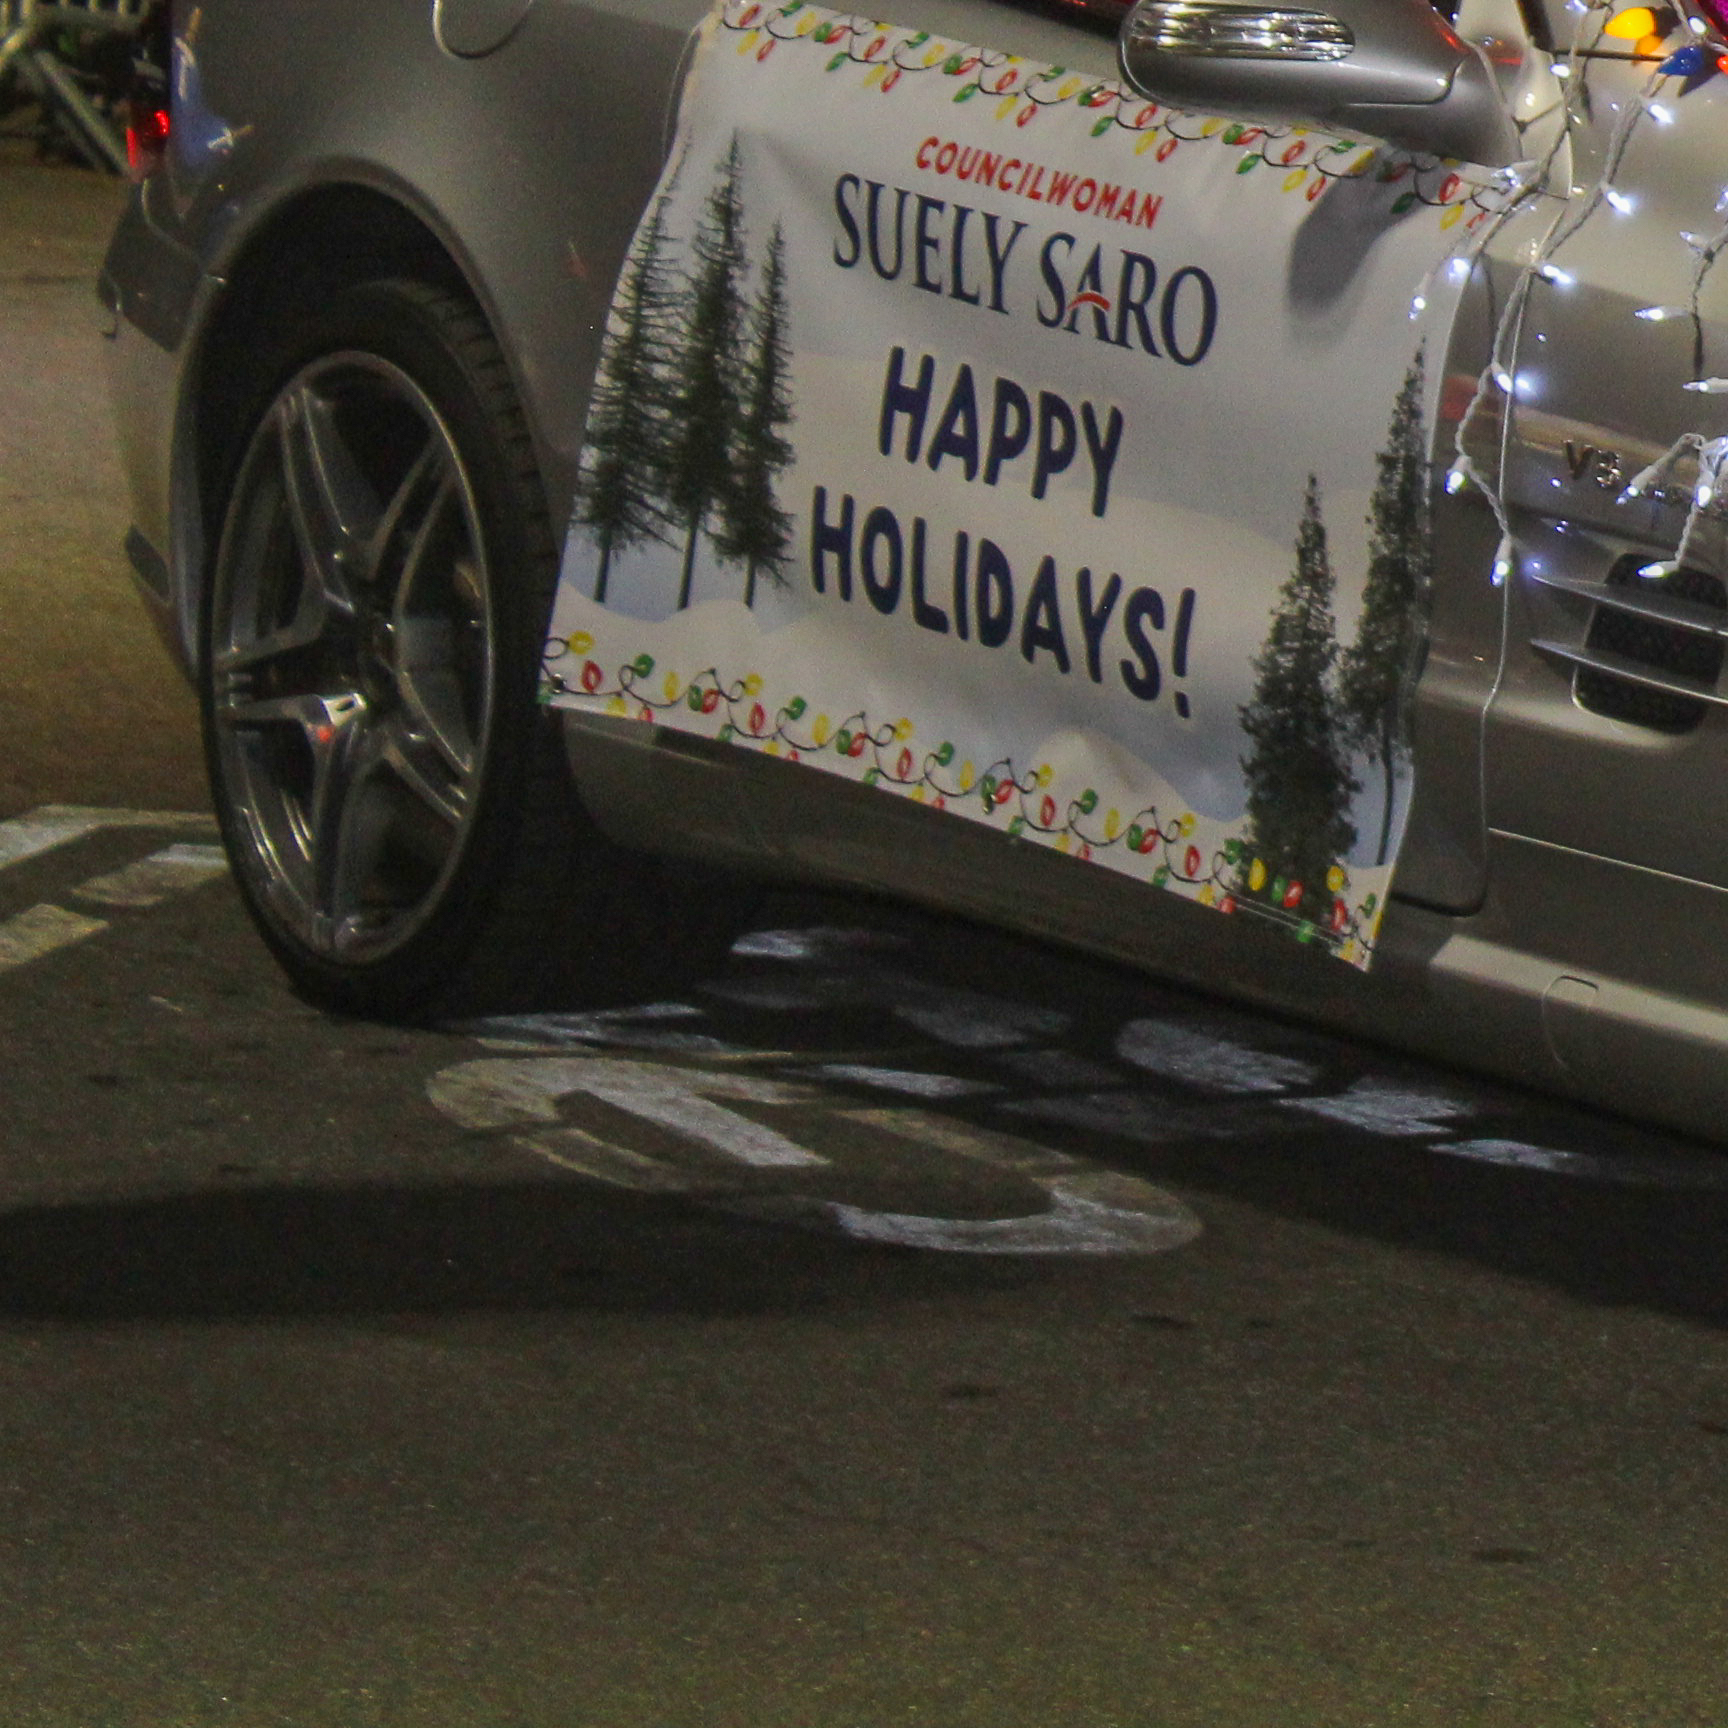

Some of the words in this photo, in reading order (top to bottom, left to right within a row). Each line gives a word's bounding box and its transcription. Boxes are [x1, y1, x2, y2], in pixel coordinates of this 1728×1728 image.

[832, 172, 1028, 318] SUELY
[1036, 231, 1218, 367] SARO
[915, 135, 1164, 231] COUNCILWOMAN
[878, 345, 1123, 519] HAPPY
[810, 485, 1196, 719] HOLIDAYS!
